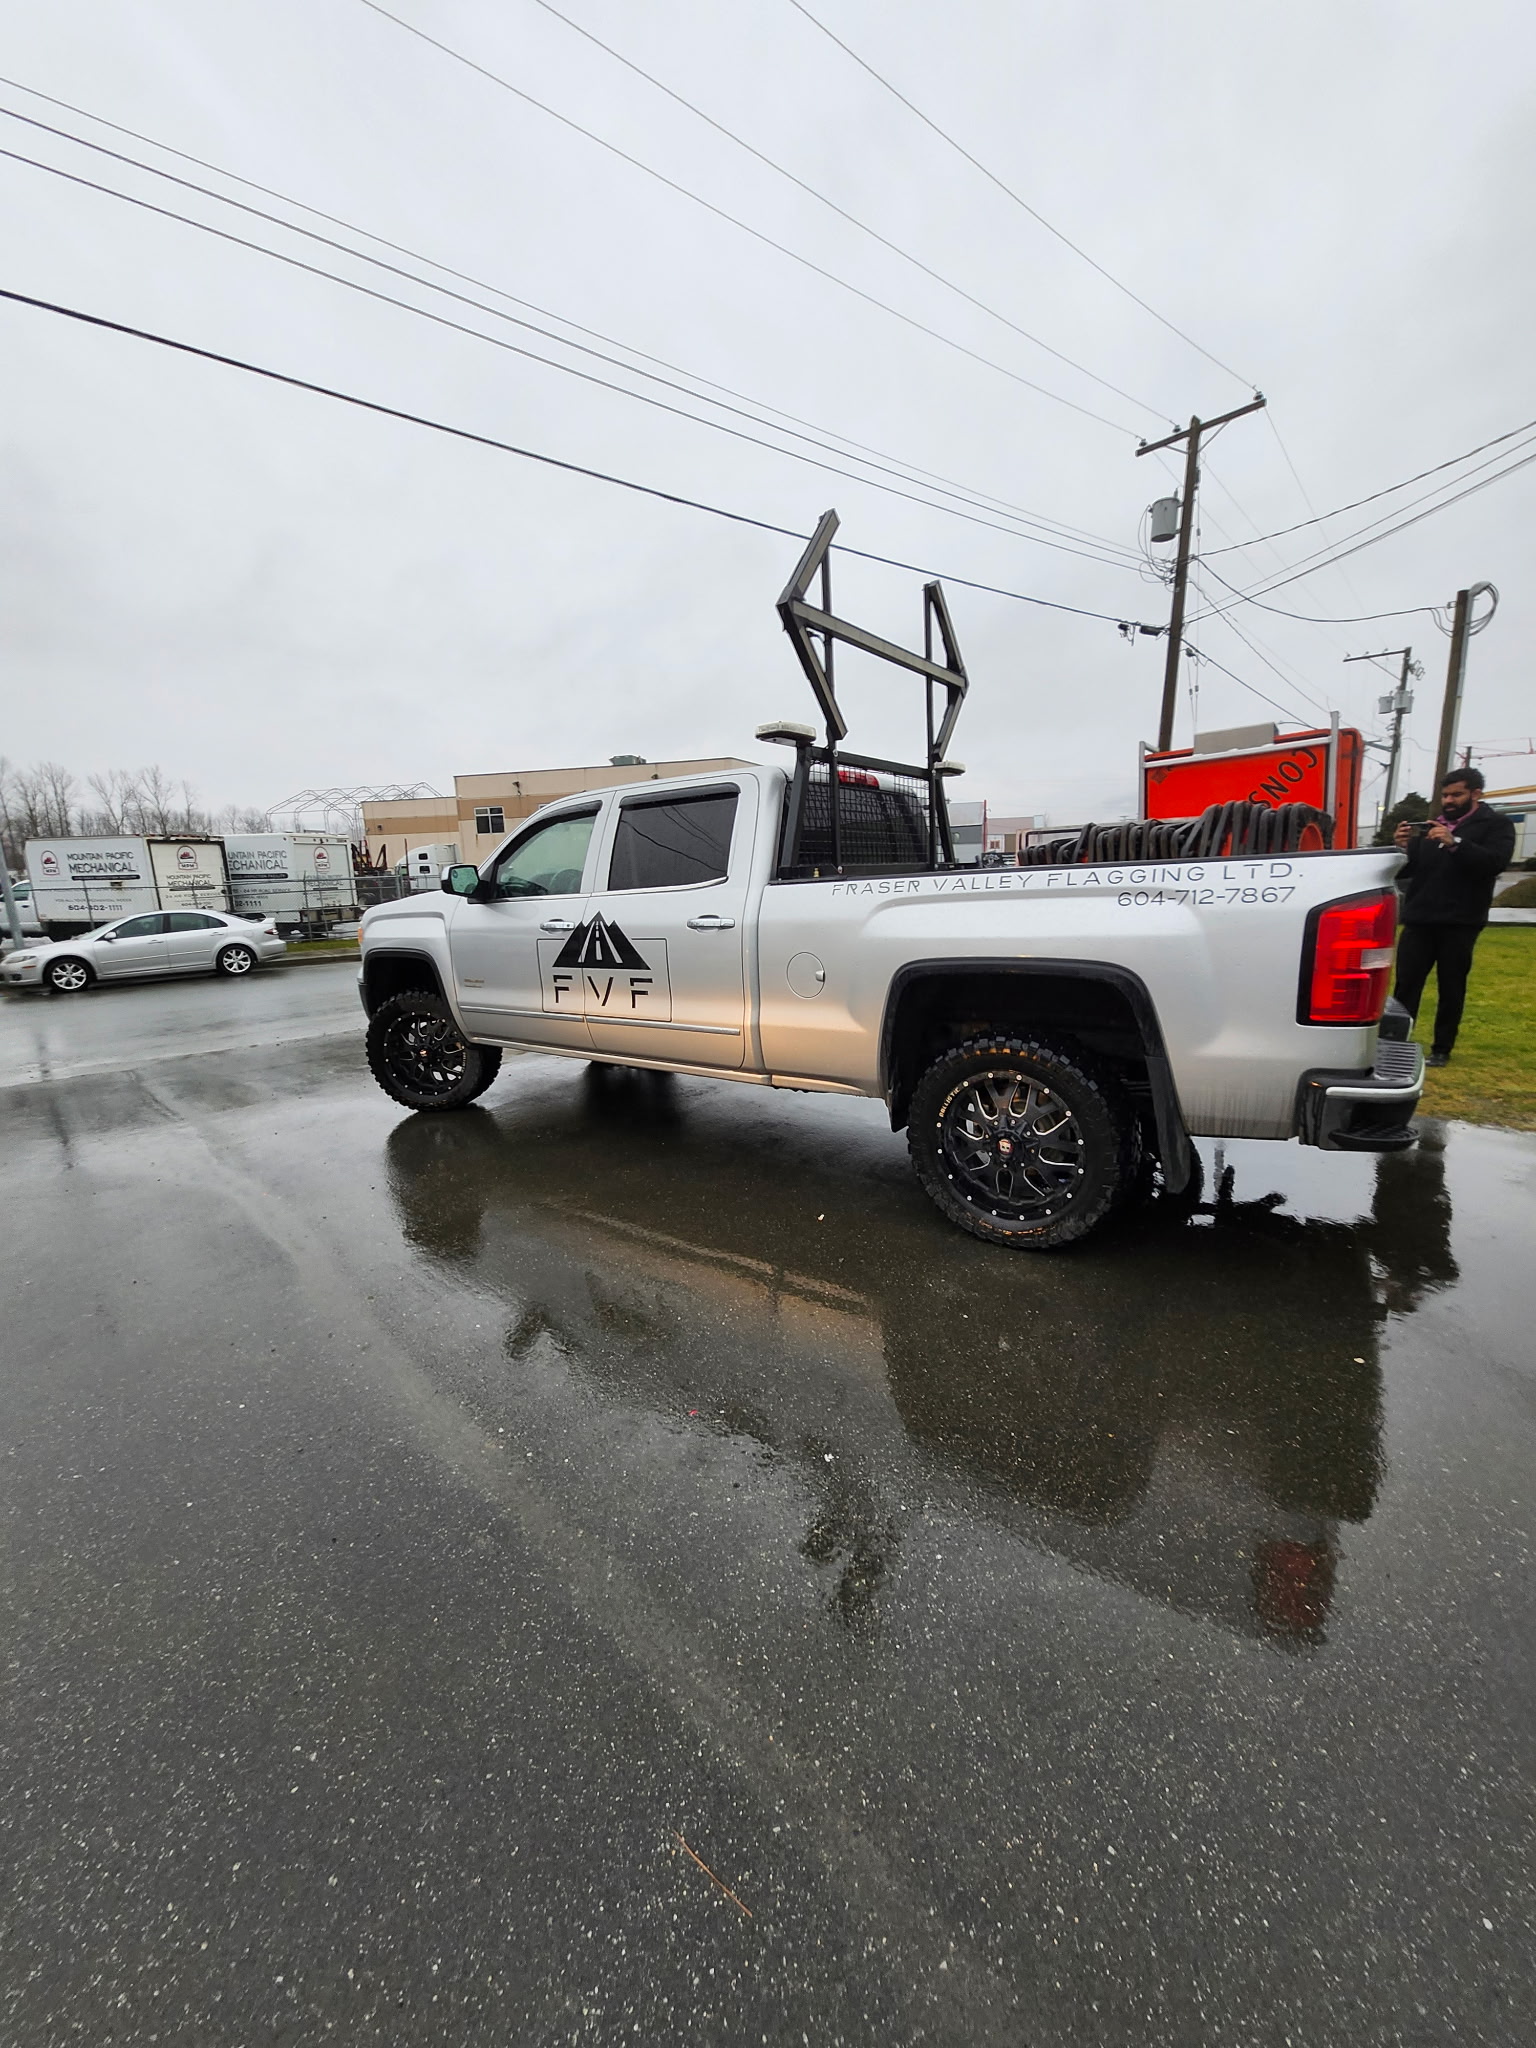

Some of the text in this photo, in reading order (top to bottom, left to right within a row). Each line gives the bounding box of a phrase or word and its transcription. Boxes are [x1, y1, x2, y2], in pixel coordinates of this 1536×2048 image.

[67, 851, 134, 861] MOUNTAIN PACIFIC
[228, 850, 287, 860] UNTAIN PACIFIC
[69, 862, 136, 873] MECHANICAL
[229, 859, 288, 870] ECHANICAL
[832, 862, 1304, 896] FRASER VALLEY FLAGGING LTD.
[1117, 886, 1296, 907] 604-712-7867
